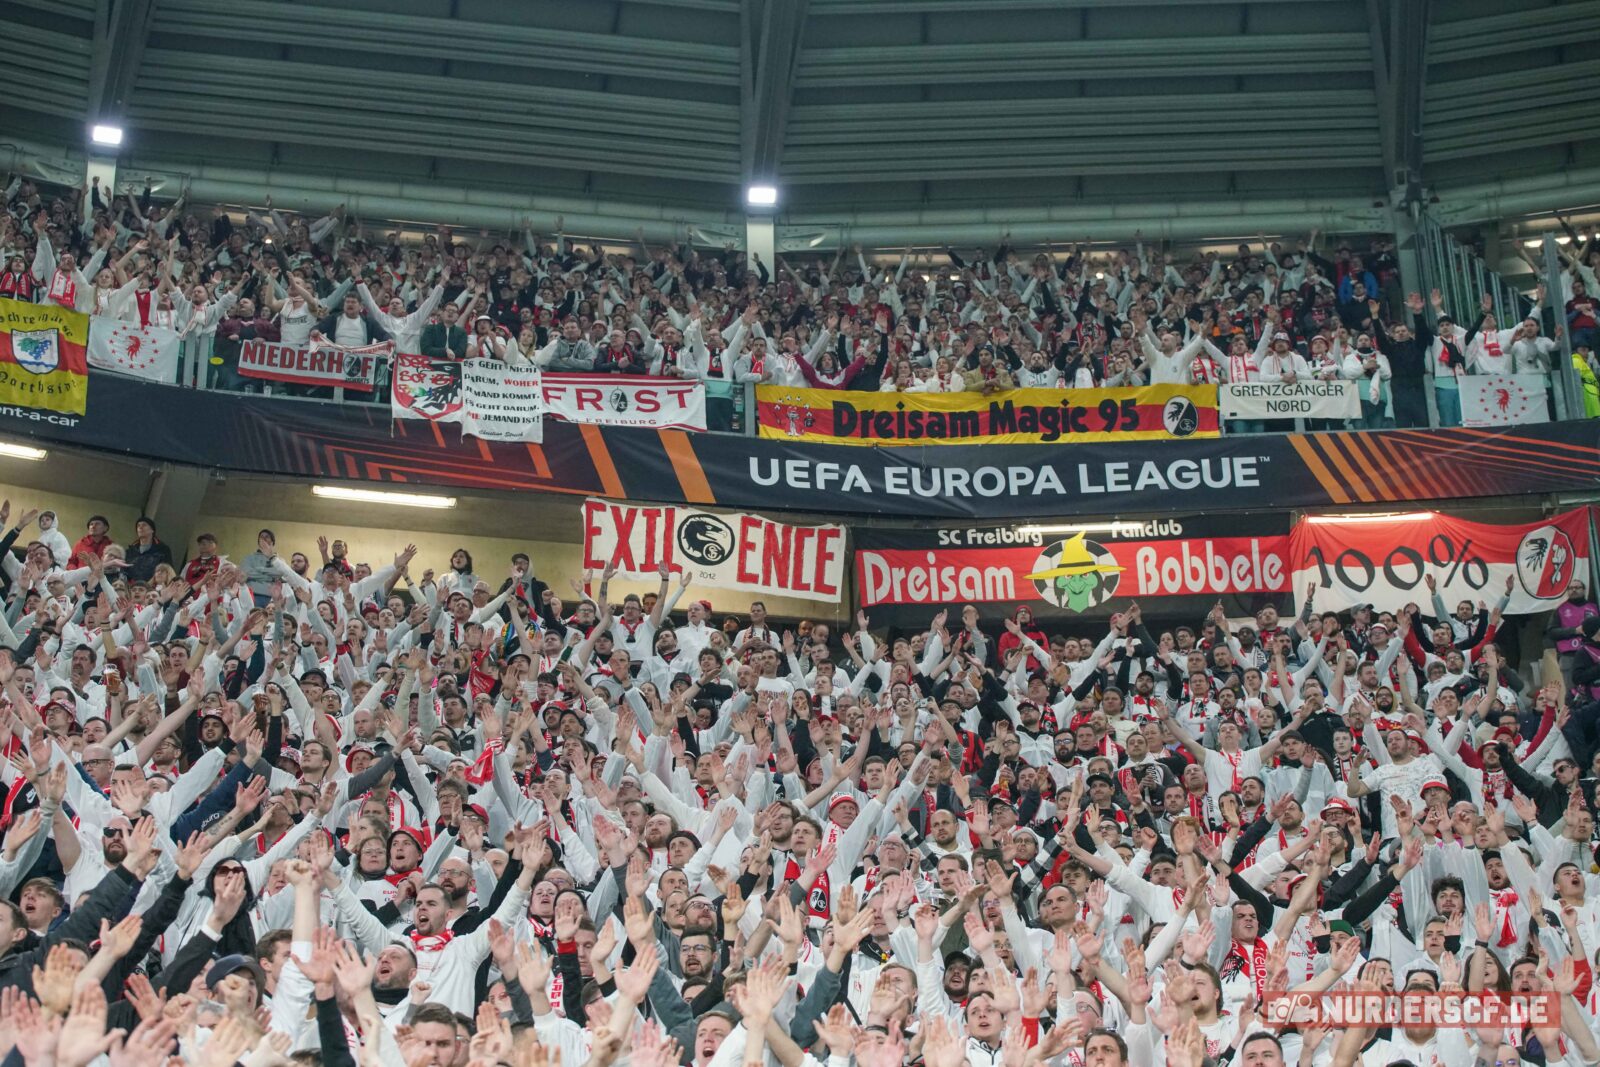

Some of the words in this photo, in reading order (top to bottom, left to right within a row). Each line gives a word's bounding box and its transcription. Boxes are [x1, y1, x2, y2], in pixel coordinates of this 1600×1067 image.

[478, 360, 503, 371] GEHT
[509, 365, 537, 374] NICHT
[503, 378, 539, 387] WOHER
[1230, 384, 1344, 397] GRENZGÄNGER
[475, 402, 500, 411] GEHT
[1266, 399, 1312, 413] NORD
[0, 407, 80, 427] nt-a-car
[482, 413, 521, 424] JEMAND
[832, 400, 979, 439] Dreisam
[988, 399, 1088, 441] Magic
[1097, 398, 1142, 431] 95
[748, 455, 872, 493] UEFA
[884, 463, 1066, 498] EUROPA
[583, 501, 683, 575] EXIL
[938, 530, 962, 546] SC
[966, 527, 1043, 547] Freiburg
[1305, 533, 1489, 594] 100%
[699, 571, 717, 580] 2012
[862, 550, 1016, 606] Dreisam
[1136, 539, 1285, 596] Bobbele
